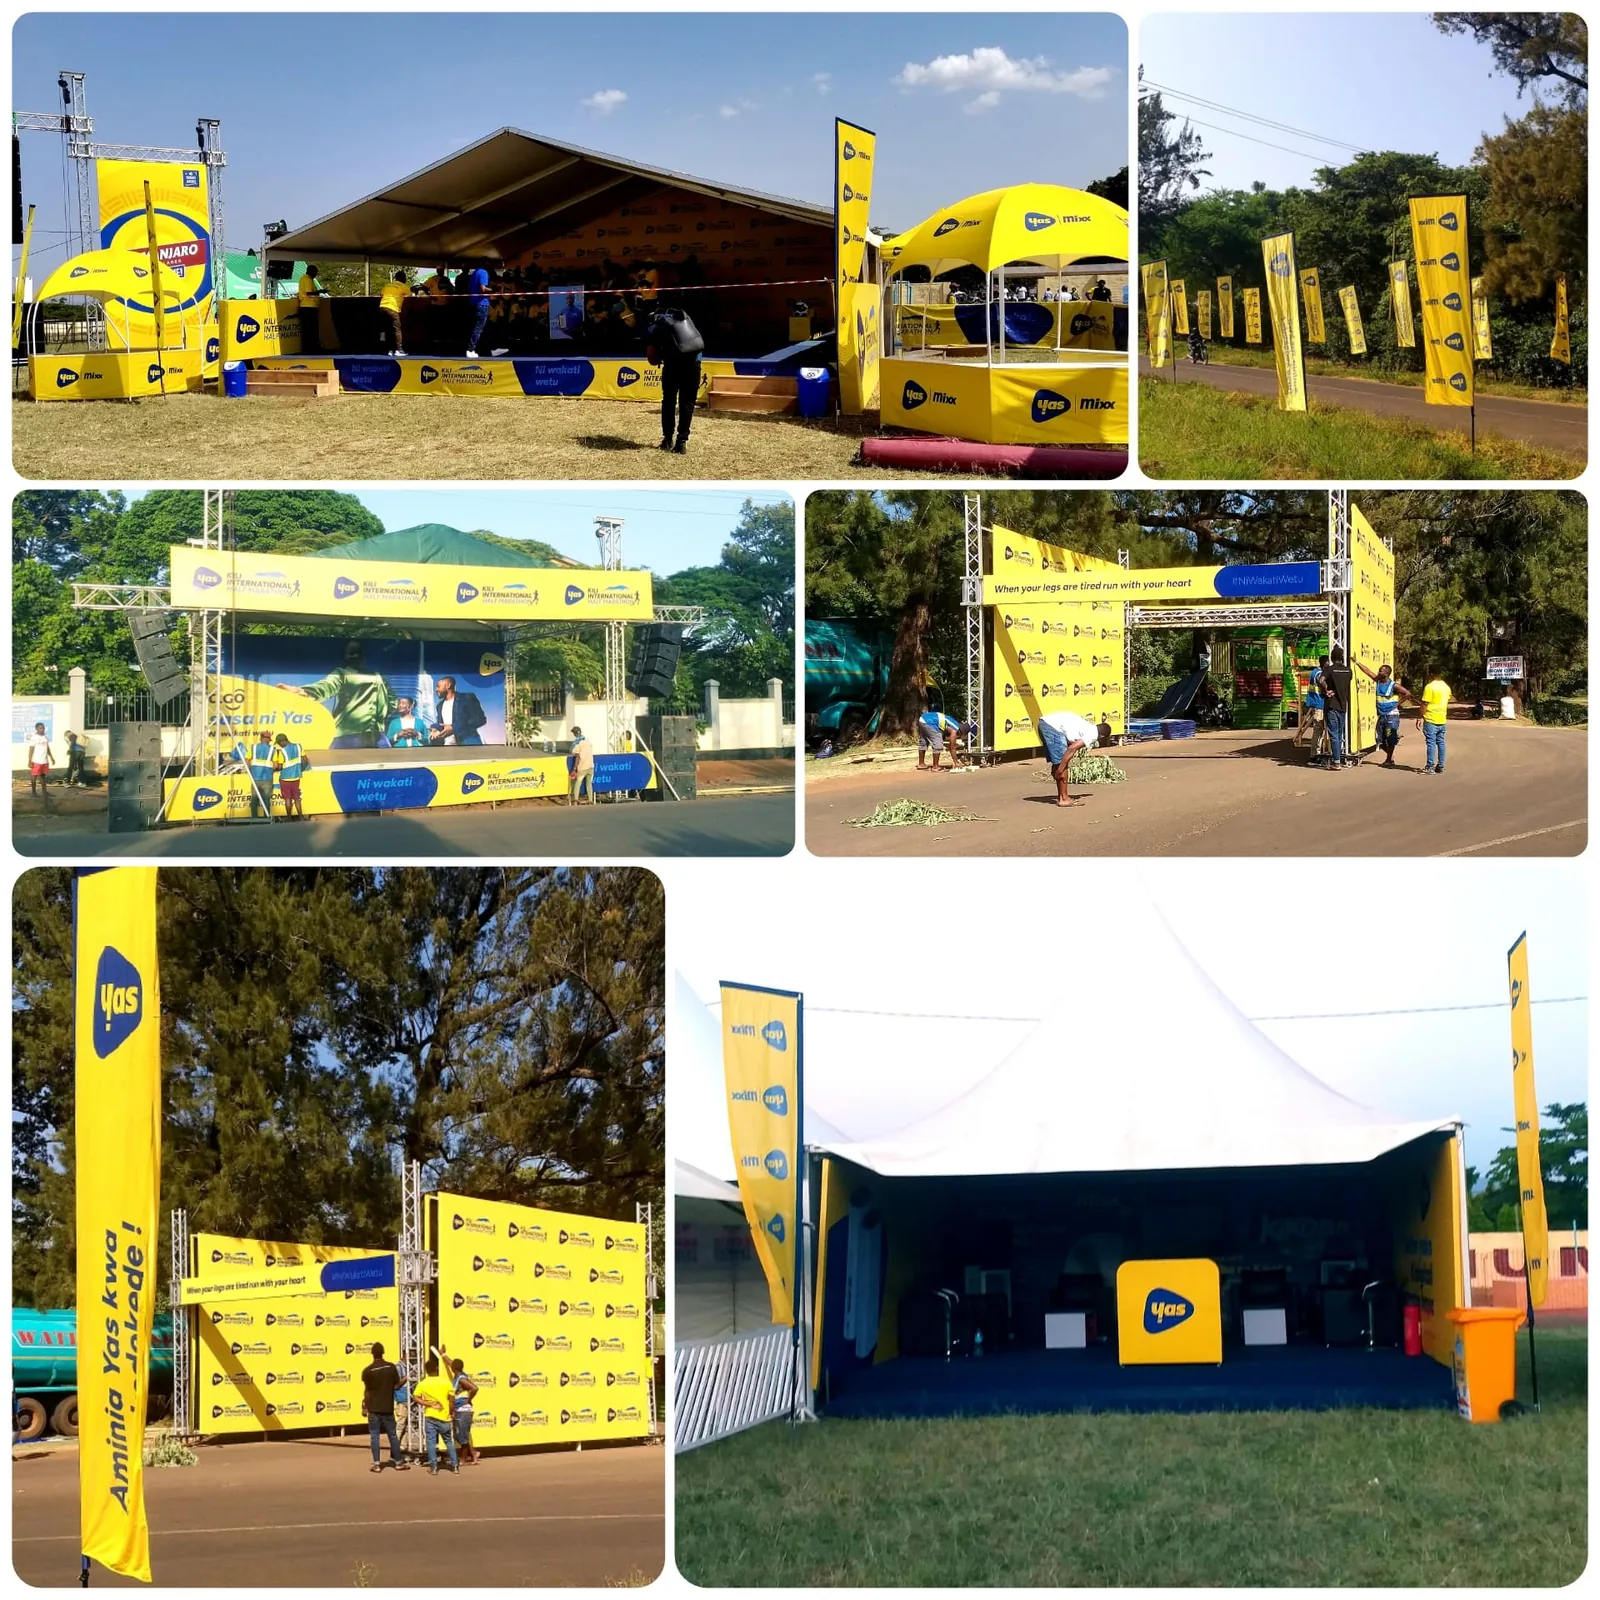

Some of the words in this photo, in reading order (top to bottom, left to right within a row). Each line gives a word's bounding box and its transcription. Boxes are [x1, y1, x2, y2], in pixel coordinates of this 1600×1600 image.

[1028, 217, 1050, 226] yas
[239, 323, 258, 337] yas
[264, 324, 300, 333] INTERNATIO
[280, 331, 300, 339] MARAT
[535, 366, 546, 374] Ni
[548, 365, 580, 374] wakati
[60, 374, 75, 384] yas
[84, 372, 103, 380] Mixx
[352, 375, 372, 384] wetu
[422, 371, 437, 381] yas
[442, 372, 486, 380] INTERNATIONAL
[535, 377, 558, 386] wetu
[620, 372, 637, 383] yas
[906, 389, 923, 403] yas
[933, 392, 957, 405] Mixx
[1037, 399, 1064, 414] yas
[1080, 398, 1116, 410] Mixx
[198, 574, 217, 587] yas
[227, 579, 291, 589] INTERNATIONAL
[995, 584, 1020, 594] When
[1021, 584, 1041, 594] your
[1043, 583, 1061, 593] legs
[1080, 581, 1101, 590] tired
[1120, 580, 1141, 589] with
[1143, 581, 1165, 590] your
[1166, 578, 1192, 588] heart
[337, 583, 355, 594] yas
[363, 587, 419, 595] INTERNATIONAL
[460, 589, 476, 599] yas
[567, 591, 582, 601] yas
[484, 658, 502, 669] yas
[260, 711, 277, 725] ni
[283, 711, 313, 725] Yas
[600, 761, 632, 771] wakati
[357, 779, 371, 789] Ni
[373, 777, 413, 789] wakati
[465, 778, 482, 788] yas
[488, 776, 538, 785] INTERNATIONAL
[504, 781, 538, 790] MARATHON
[197, 795, 218, 806] yas
[357, 792, 386, 803] wetu
[101, 983, 138, 1032] yas
[101, 1229, 118, 1310] kwa
[236, 1282, 248, 1290] tired
[260, 1279, 273, 1287] with
[275, 1279, 287, 1288] your
[1151, 1301, 1187, 1324] yas
[103, 1317, 121, 1374] Yas
[105, 1392, 129, 1515] Aminia
